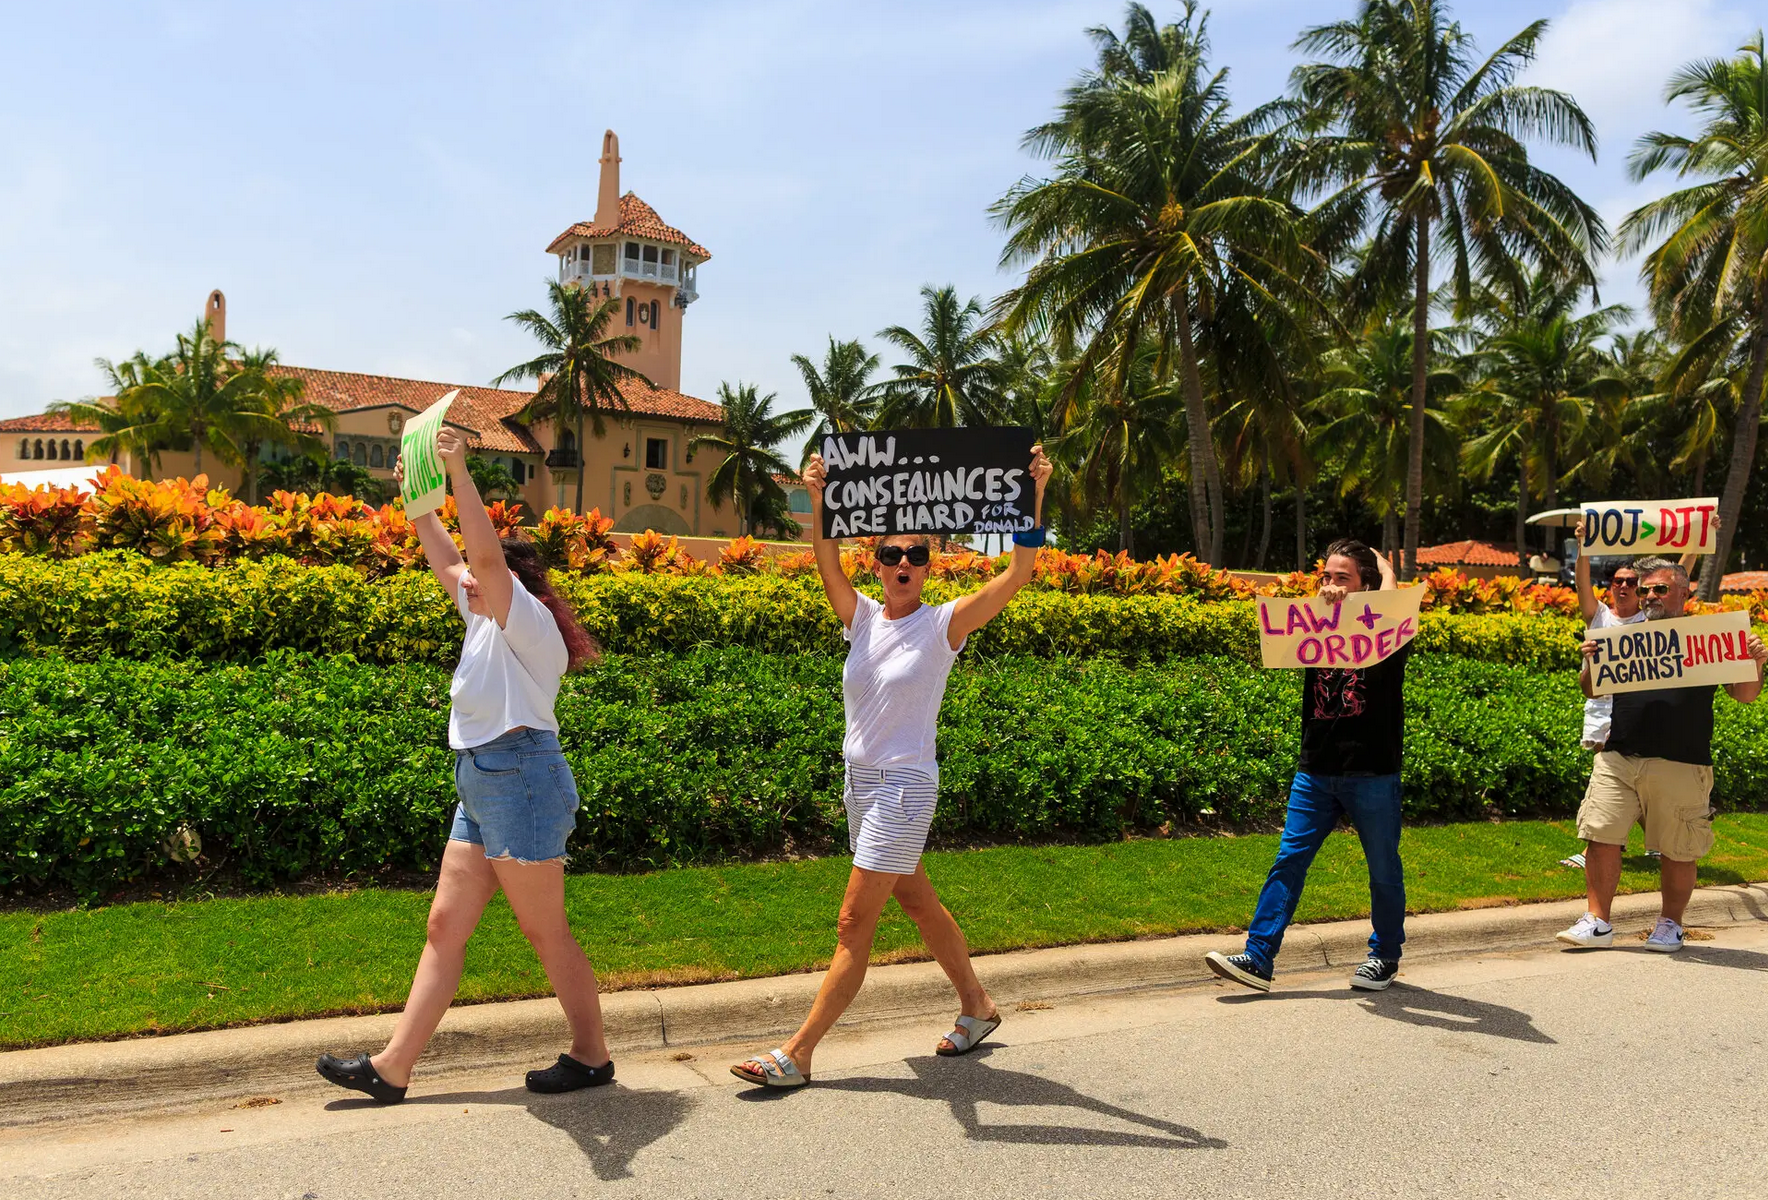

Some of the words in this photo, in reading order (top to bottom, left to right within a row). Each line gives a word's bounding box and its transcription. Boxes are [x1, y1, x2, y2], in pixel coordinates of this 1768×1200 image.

[823, 436, 940, 472] AWW...
[824, 467, 1024, 510] CONSEQUNCES
[830, 507, 888, 538] ARE
[896, 502, 975, 531] HARD
[973, 516, 1035, 535] DONALD
[981, 502, 1021, 519] FOR
[1260, 600, 1342, 635] LAW
[1296, 617, 1415, 665] ORDER
[1592, 628, 1681, 664] FLORIDA
[1596, 655, 1685, 688] AGAINST
